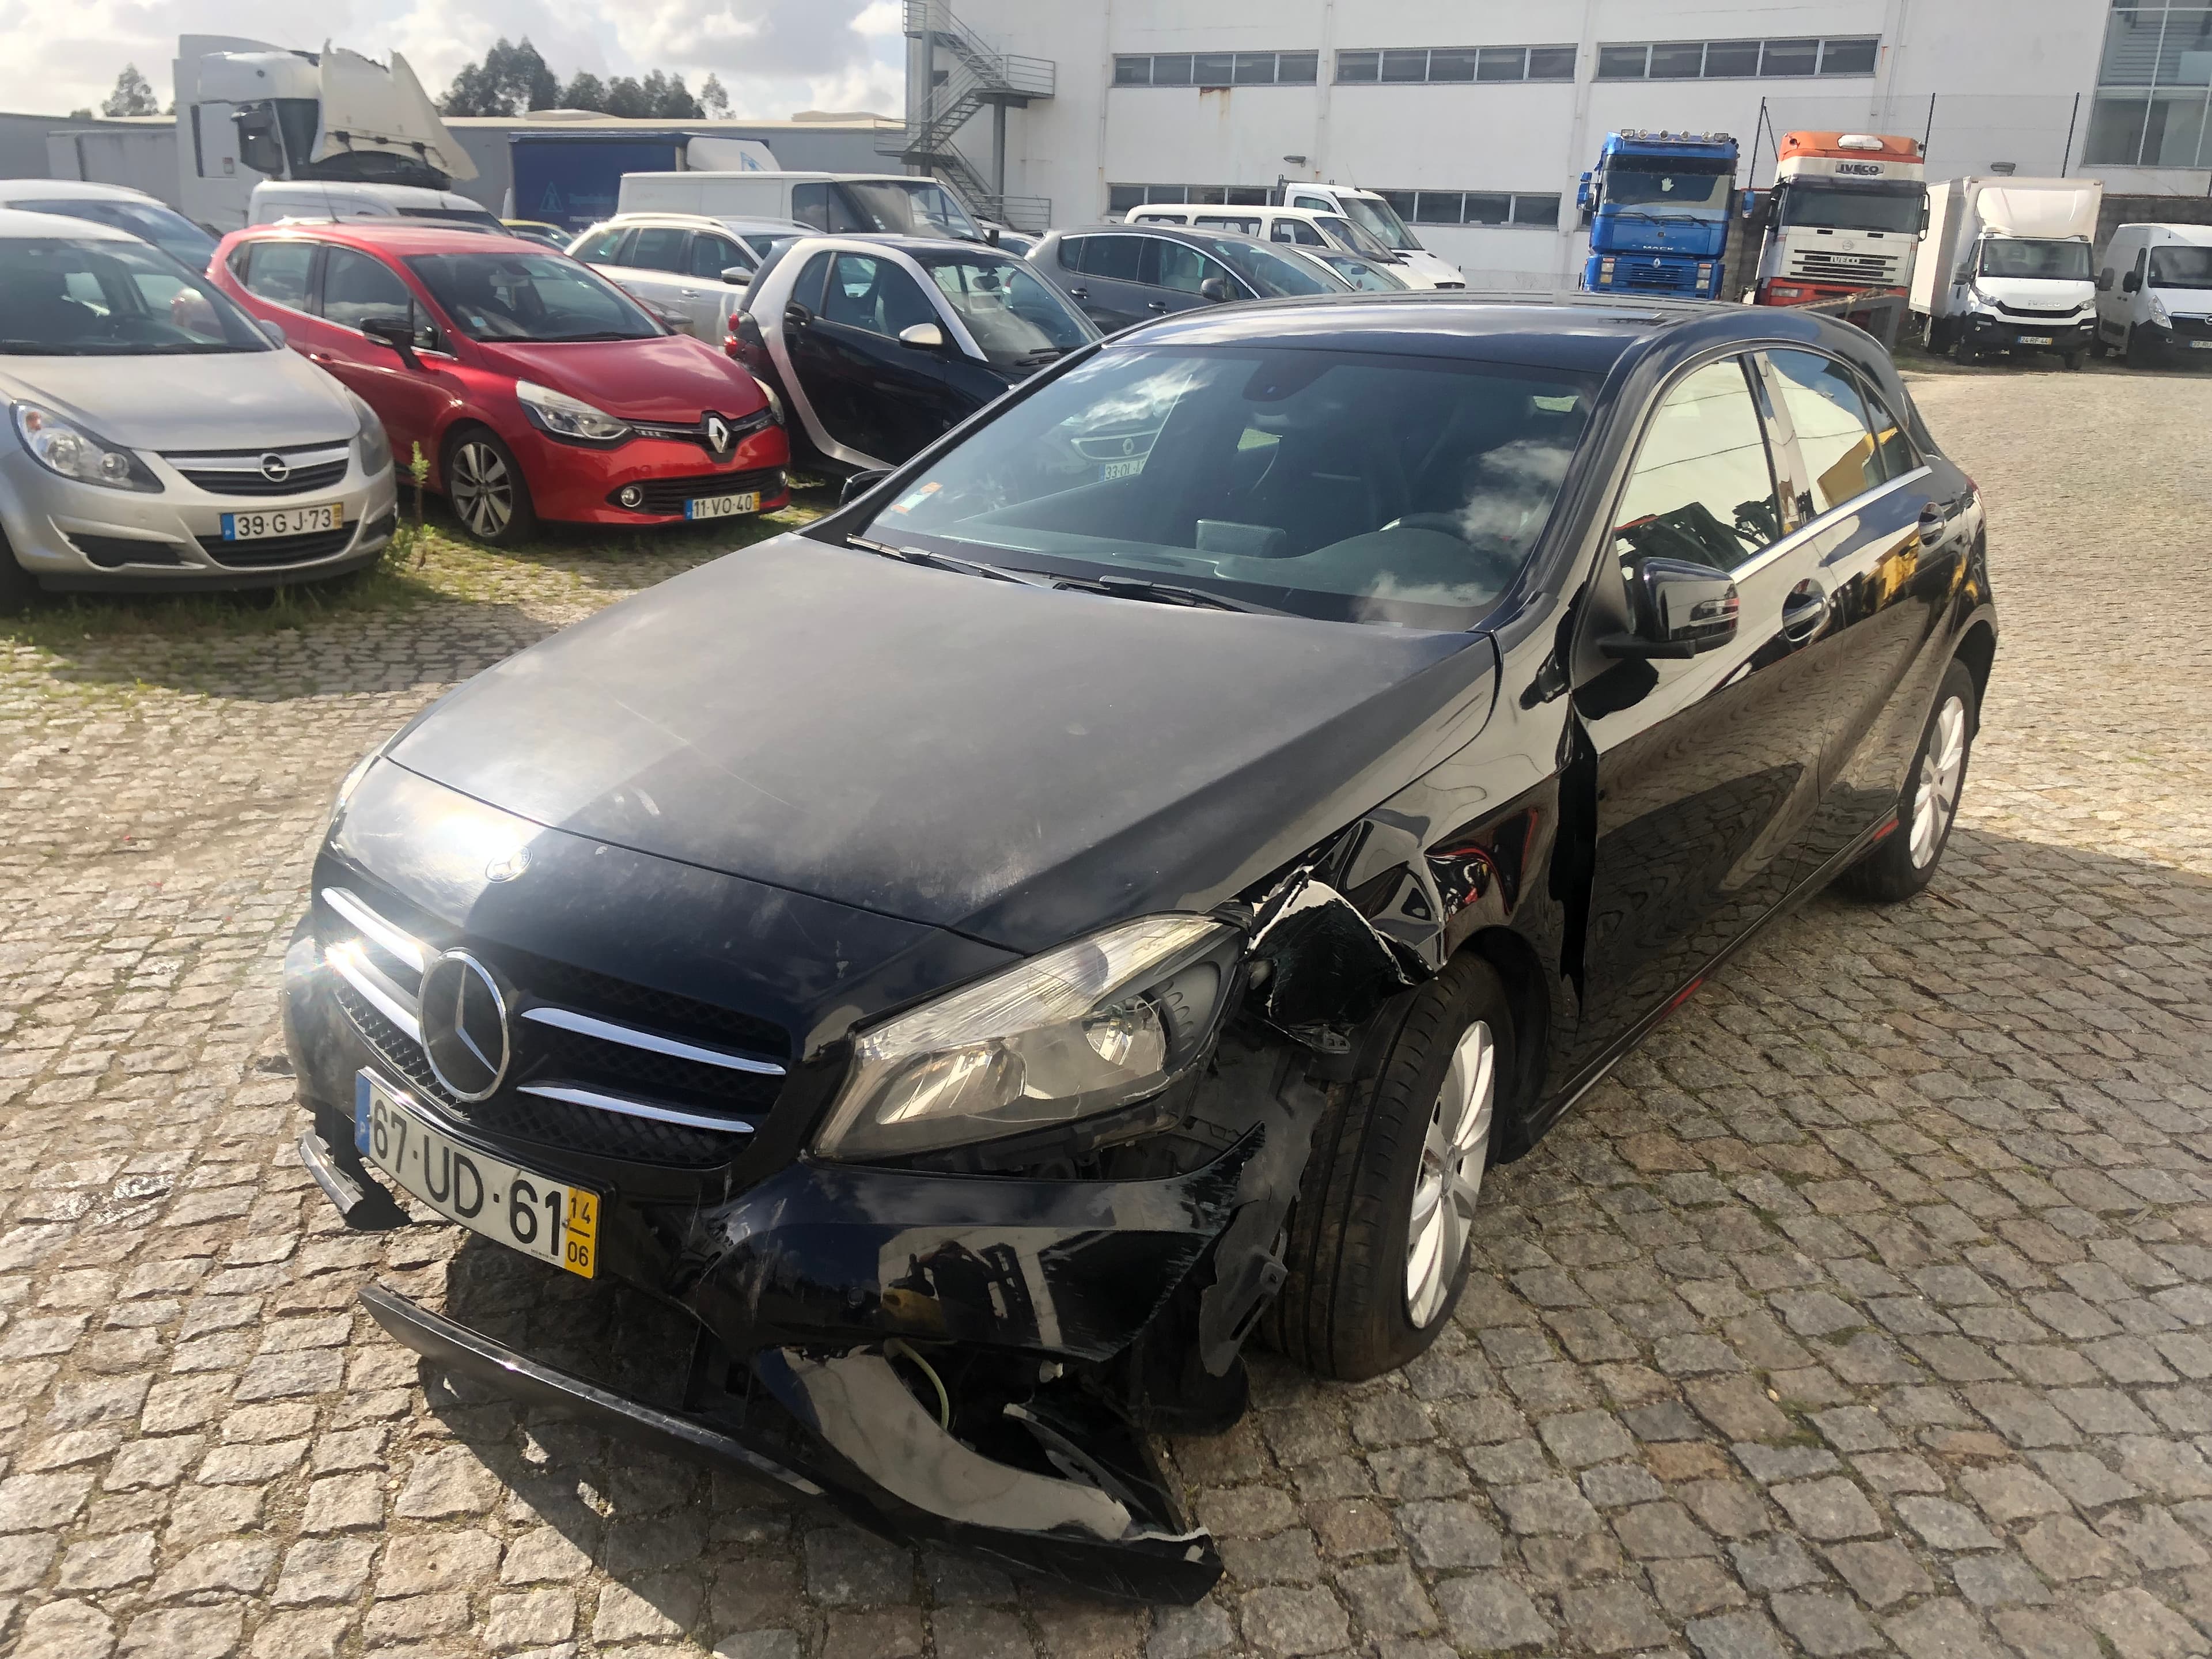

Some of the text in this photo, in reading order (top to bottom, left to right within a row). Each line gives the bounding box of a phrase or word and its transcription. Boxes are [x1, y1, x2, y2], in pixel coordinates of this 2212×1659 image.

[1840, 164, 1879, 173] IVECO
[1831, 255, 1860, 264] IVECO
[571, 1197, 591, 1225] 14
[567, 1241, 589, 1267] 06
